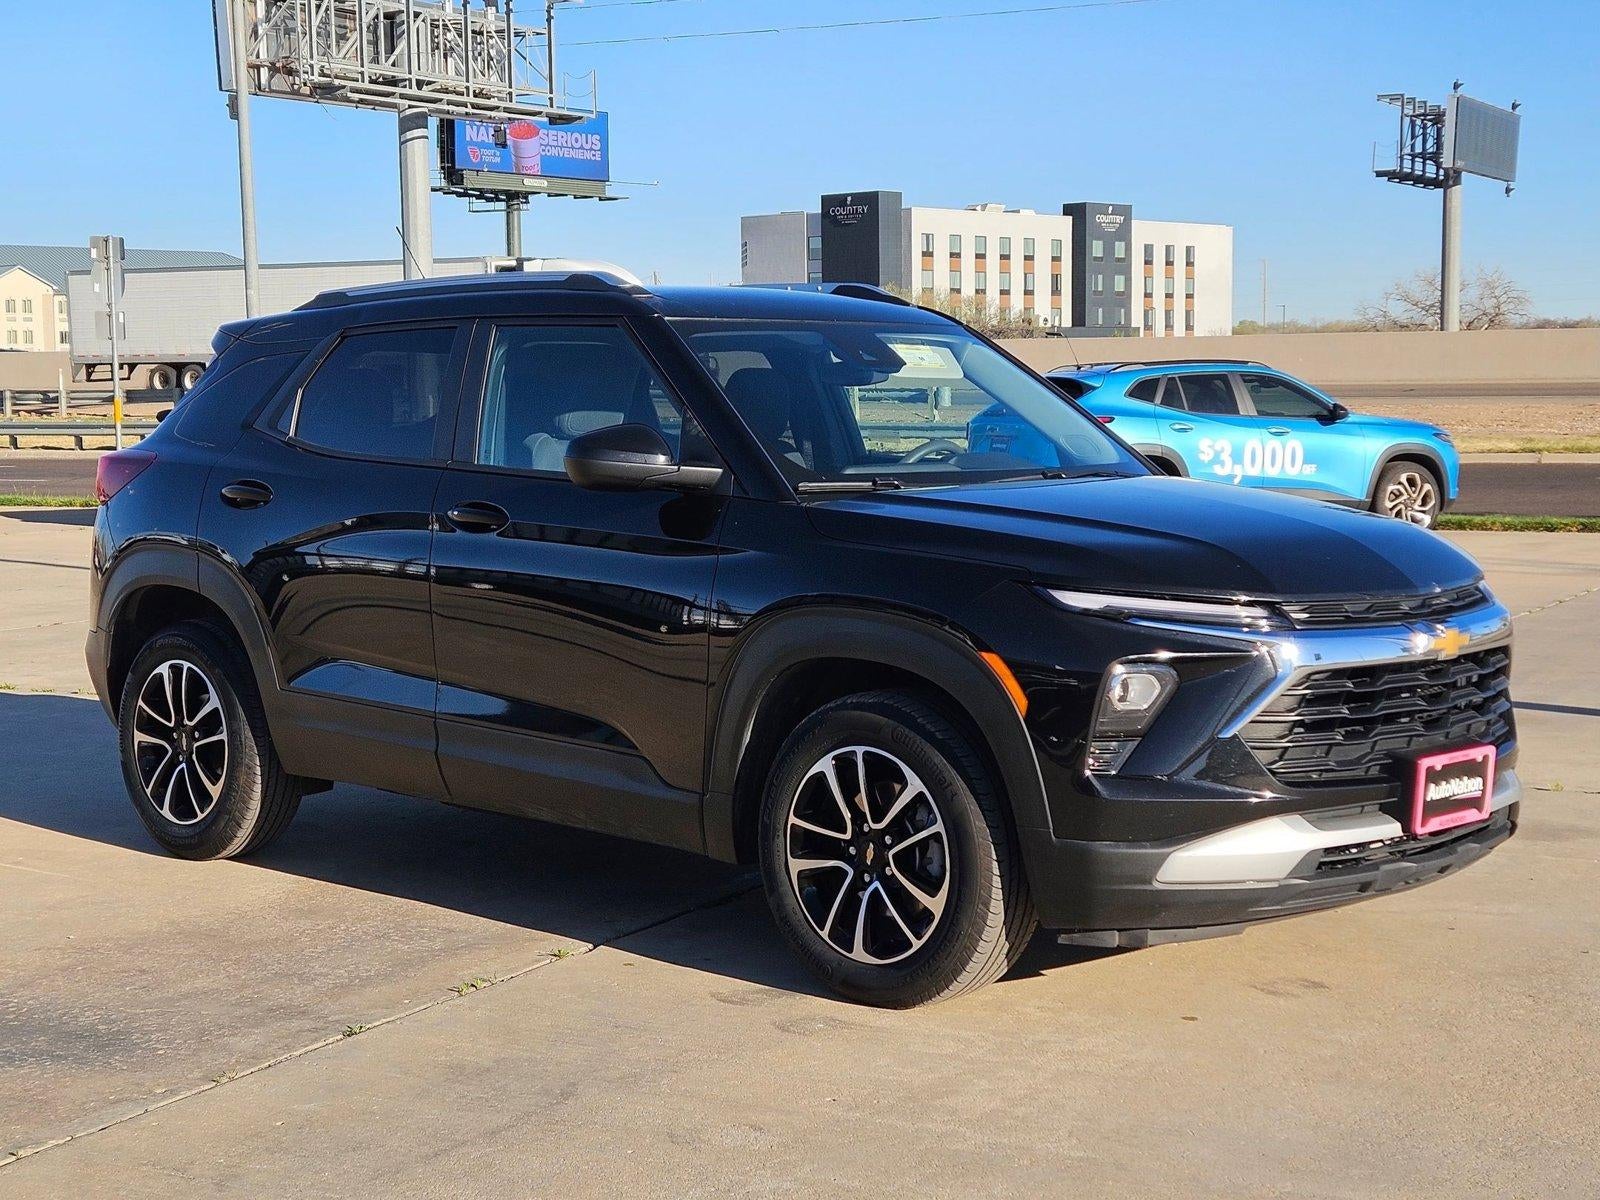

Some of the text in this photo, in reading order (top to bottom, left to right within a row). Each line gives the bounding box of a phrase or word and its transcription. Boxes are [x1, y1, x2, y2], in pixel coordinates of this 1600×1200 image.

[539, 128, 601, 150] SERIOUS
[540, 145, 602, 161] CONVENIENCE
[830, 204, 869, 216] COUNTRY
[1095, 214, 1125, 224] COUNTRY
[1198, 437, 1319, 485] $3,000 OFF
[1426, 775, 1484, 802] AutoNation
